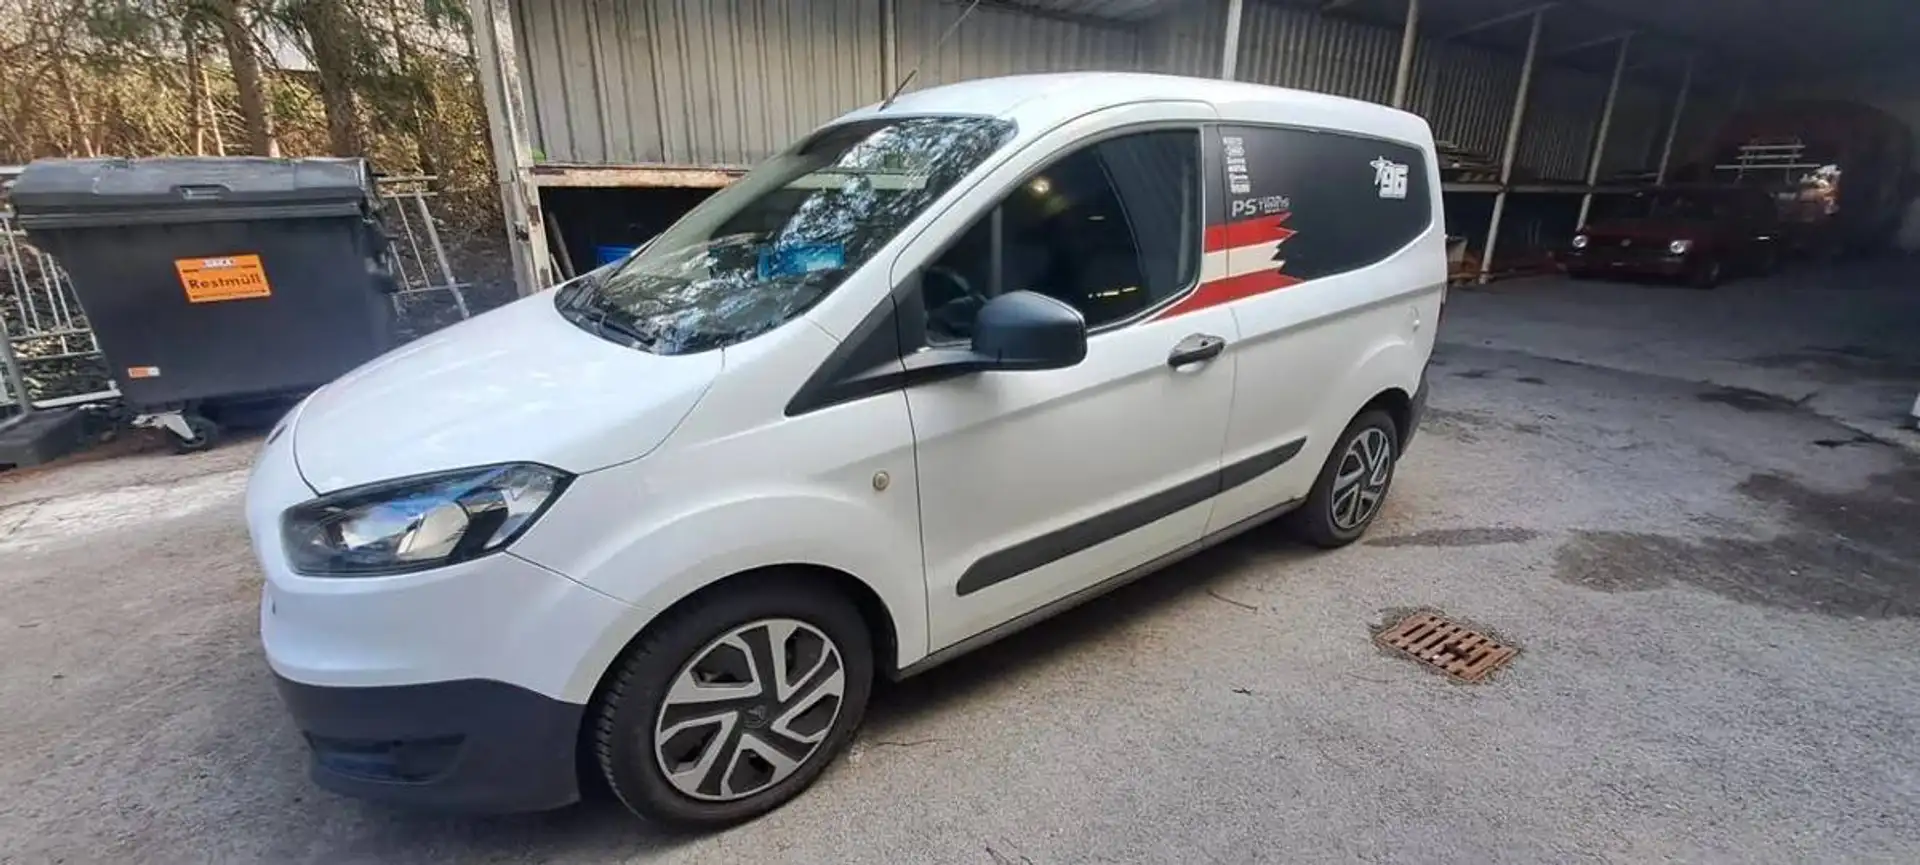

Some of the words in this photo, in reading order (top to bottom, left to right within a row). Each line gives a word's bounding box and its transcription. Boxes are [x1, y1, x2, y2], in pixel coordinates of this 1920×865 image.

[1379, 161, 1409, 199] 96
[1231, 197, 1257, 218] PS
[188, 273, 262, 290] Restmüll
